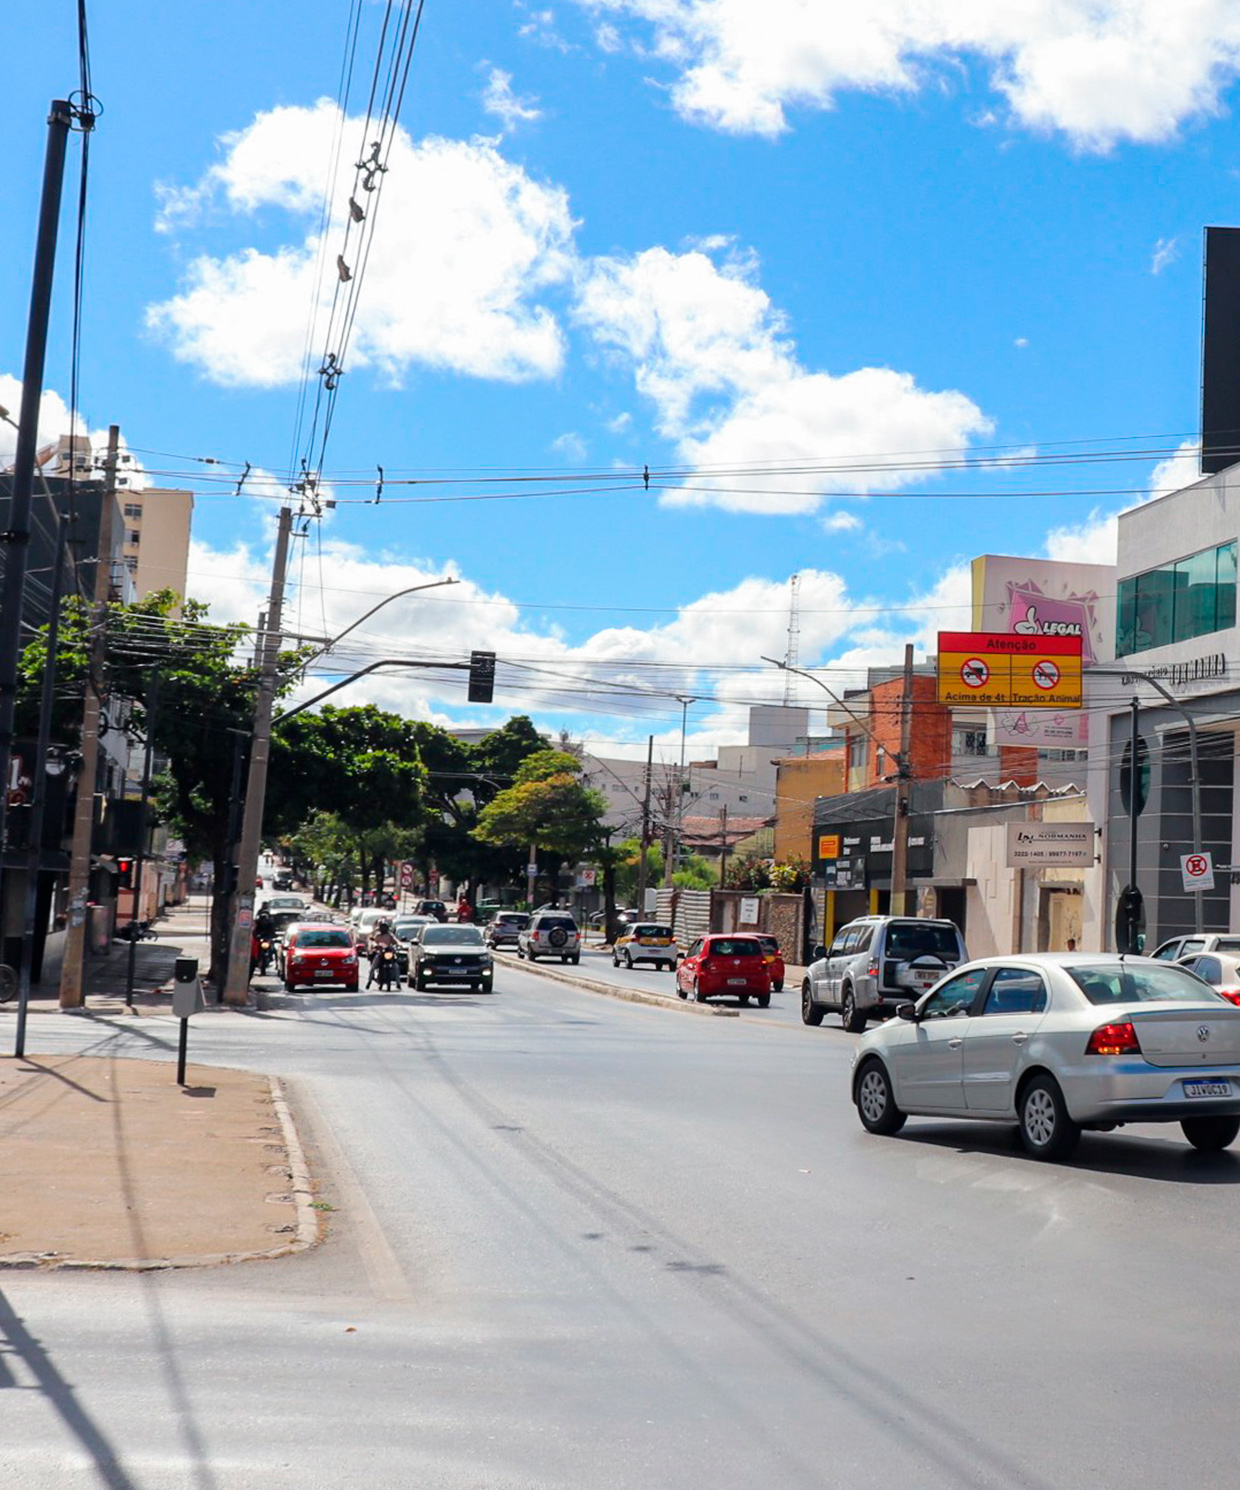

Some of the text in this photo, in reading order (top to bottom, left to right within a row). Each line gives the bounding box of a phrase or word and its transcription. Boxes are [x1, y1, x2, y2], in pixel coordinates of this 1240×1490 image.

[1043, 622, 1081, 635] LEGAL
[986, 637, 1037, 651] Atenção
[945, 692, 1005, 702] Acima de 4t
[1013, 692, 1081, 704] Tração Animal
